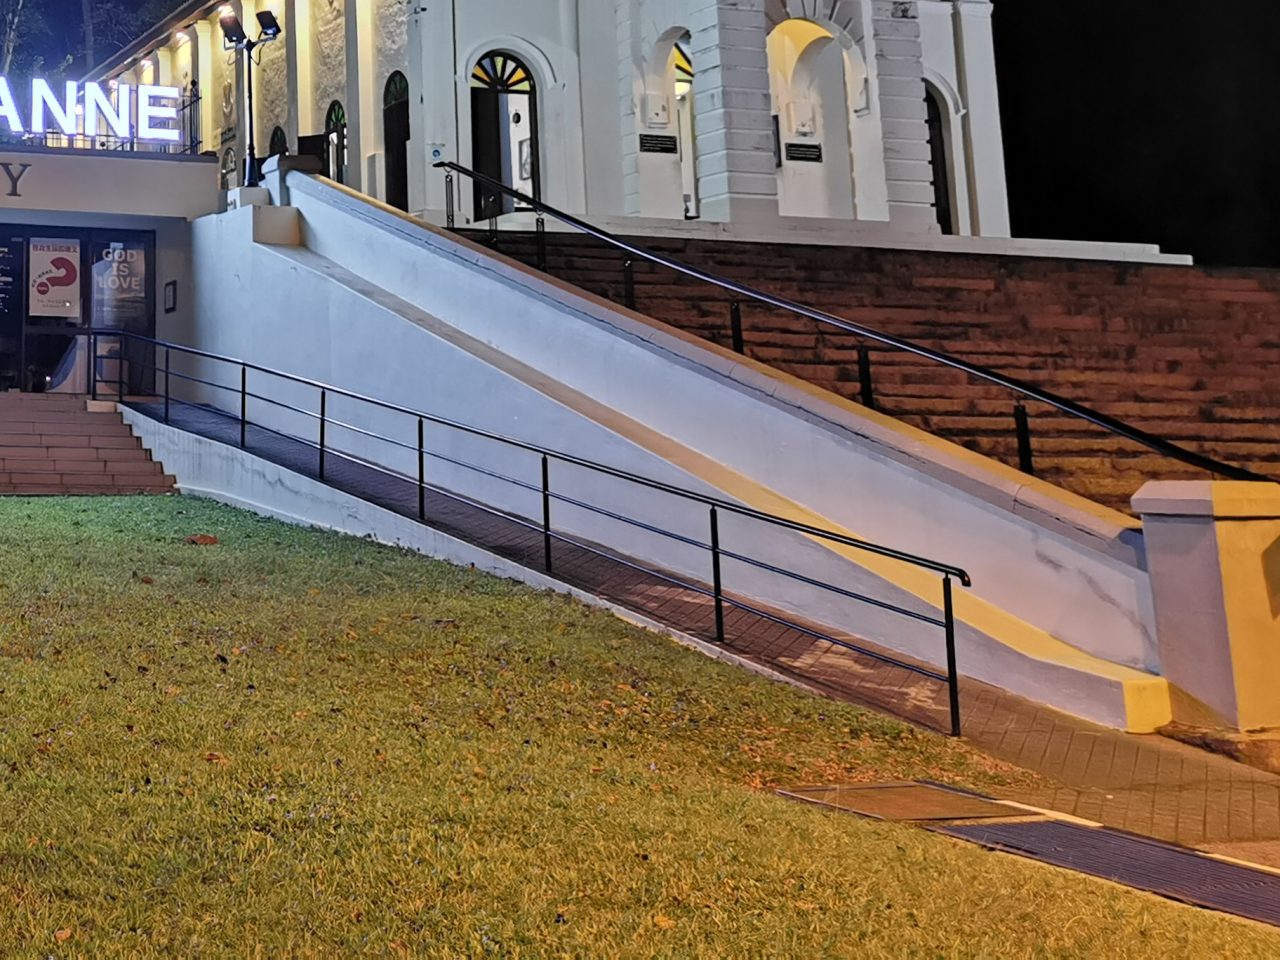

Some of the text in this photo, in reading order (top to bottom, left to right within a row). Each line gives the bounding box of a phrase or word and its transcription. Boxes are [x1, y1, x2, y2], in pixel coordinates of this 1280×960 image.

[102, 248, 137, 262] GOD
[111, 263, 130, 276] IS
[97, 276, 141, 289] LOVE
